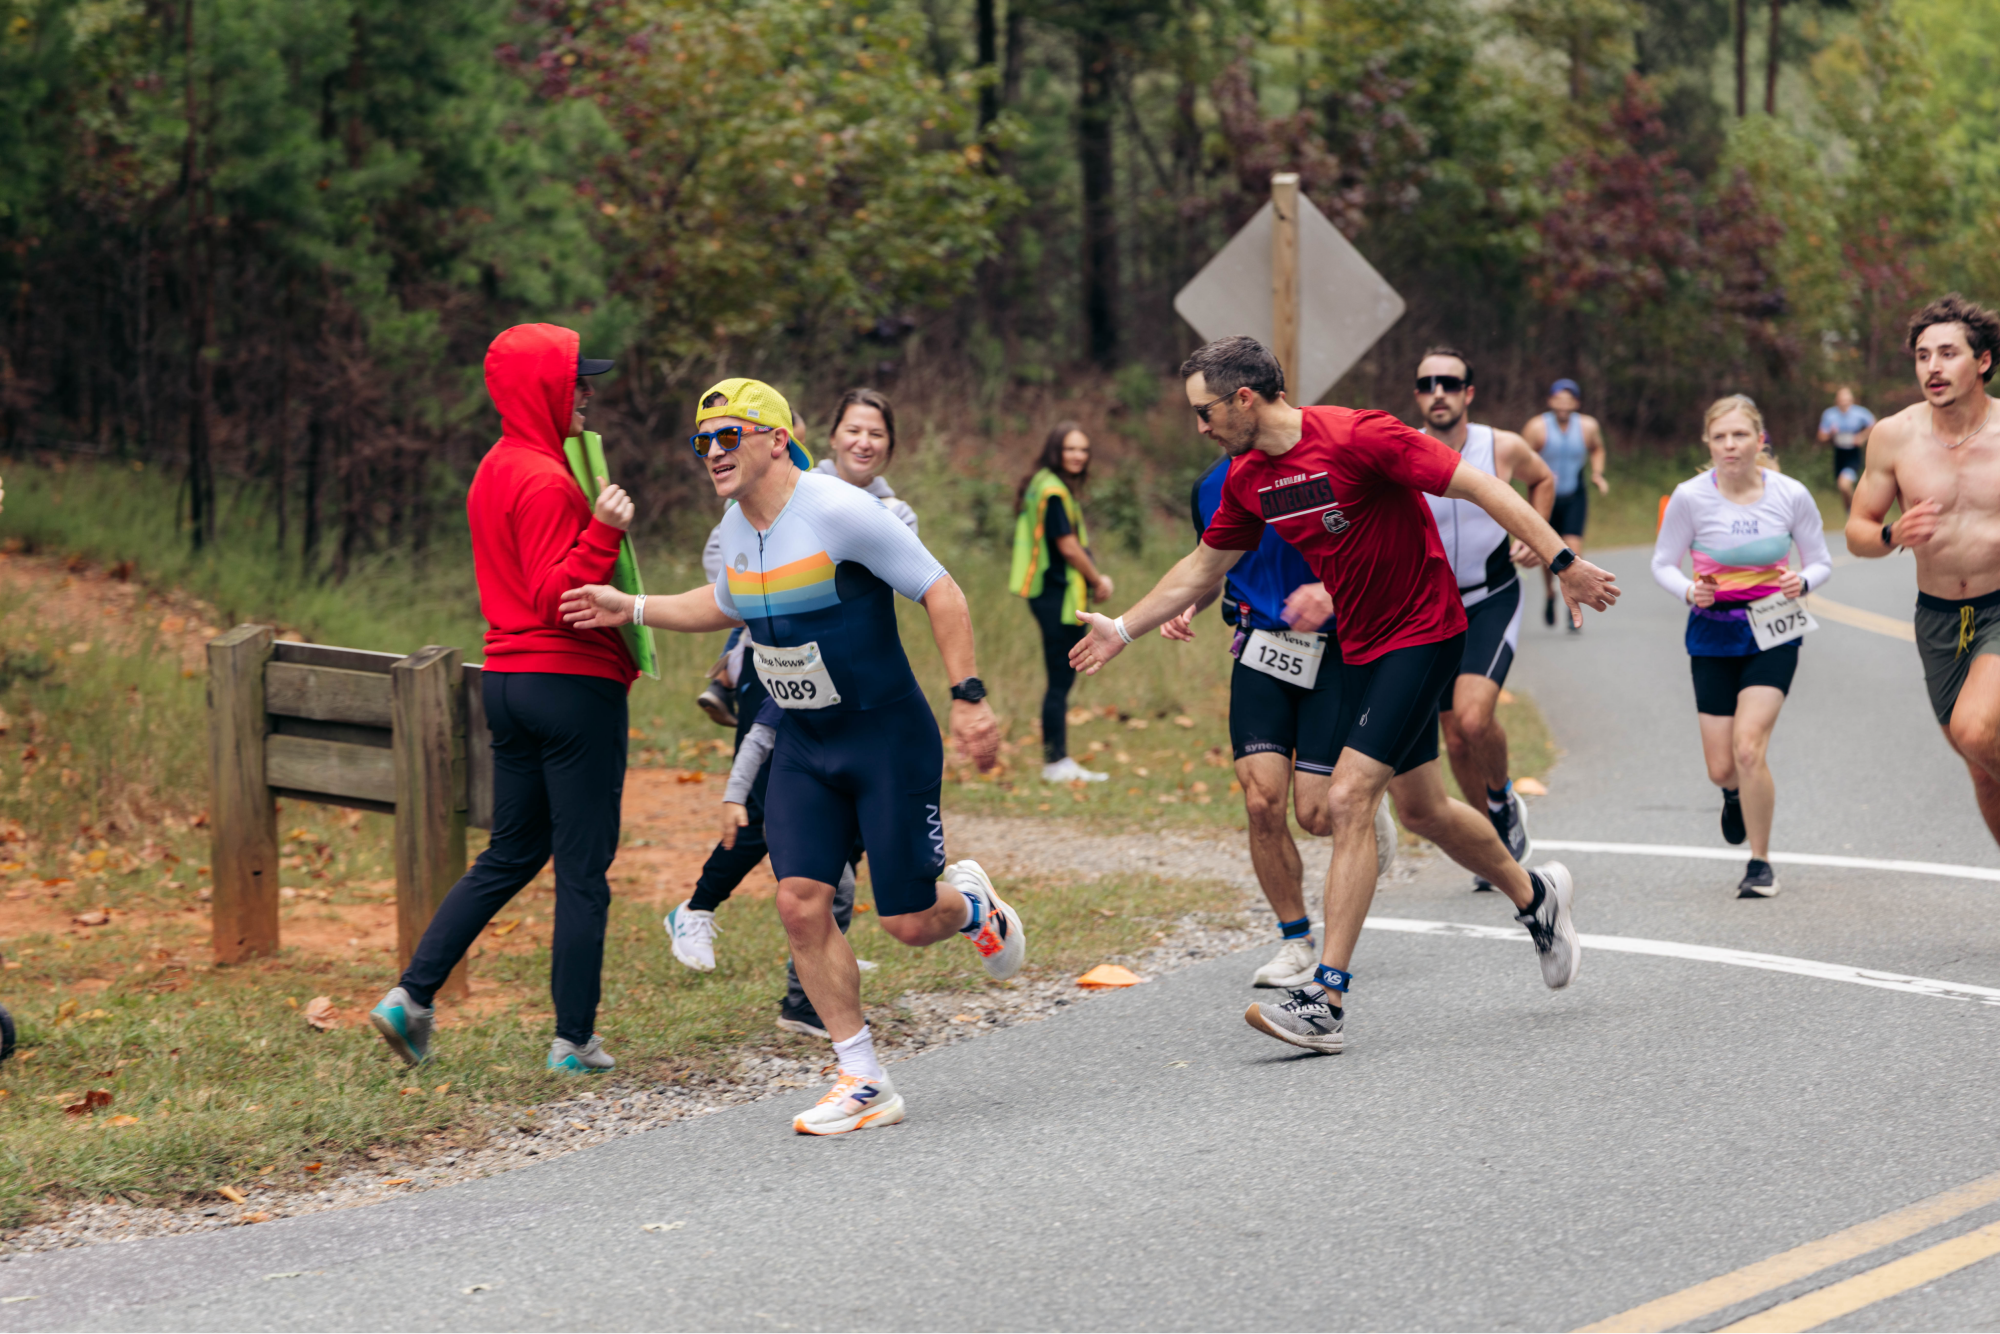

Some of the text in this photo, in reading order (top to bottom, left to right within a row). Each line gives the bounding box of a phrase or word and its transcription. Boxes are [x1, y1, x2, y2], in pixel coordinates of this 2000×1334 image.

[1261, 481, 1332, 516] GAMECOCKS
[1766, 610, 1808, 638] 1075
[1281, 632, 1311, 648] News
[774, 656, 805, 668] News
[1259, 645, 1303, 676] 1255
[766, 678, 817, 701] 1089
